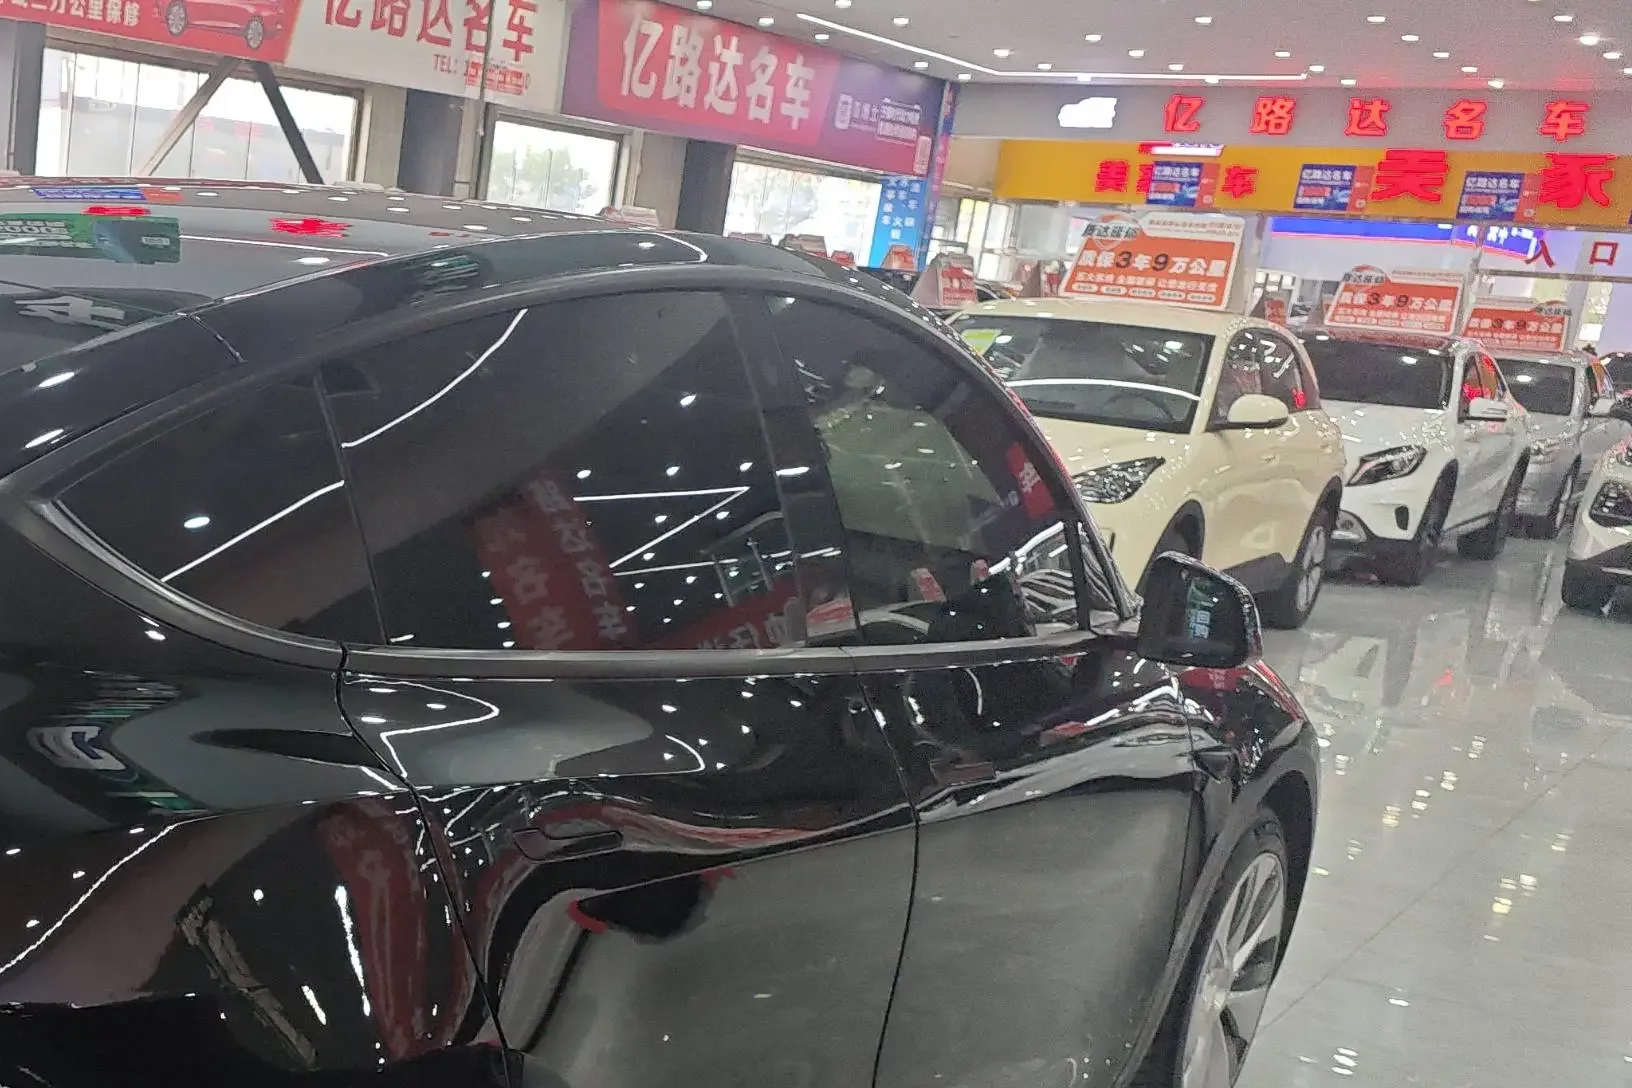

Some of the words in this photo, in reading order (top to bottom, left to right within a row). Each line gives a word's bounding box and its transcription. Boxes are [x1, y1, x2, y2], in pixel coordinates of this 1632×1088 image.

[621, 13, 815, 130] 亿路达名车
[1164, 94, 1591, 142] 亿路达名车
[1078, 250, 1227, 277] 质保3年9万公里
[1524, 240, 1619, 267] 入口
